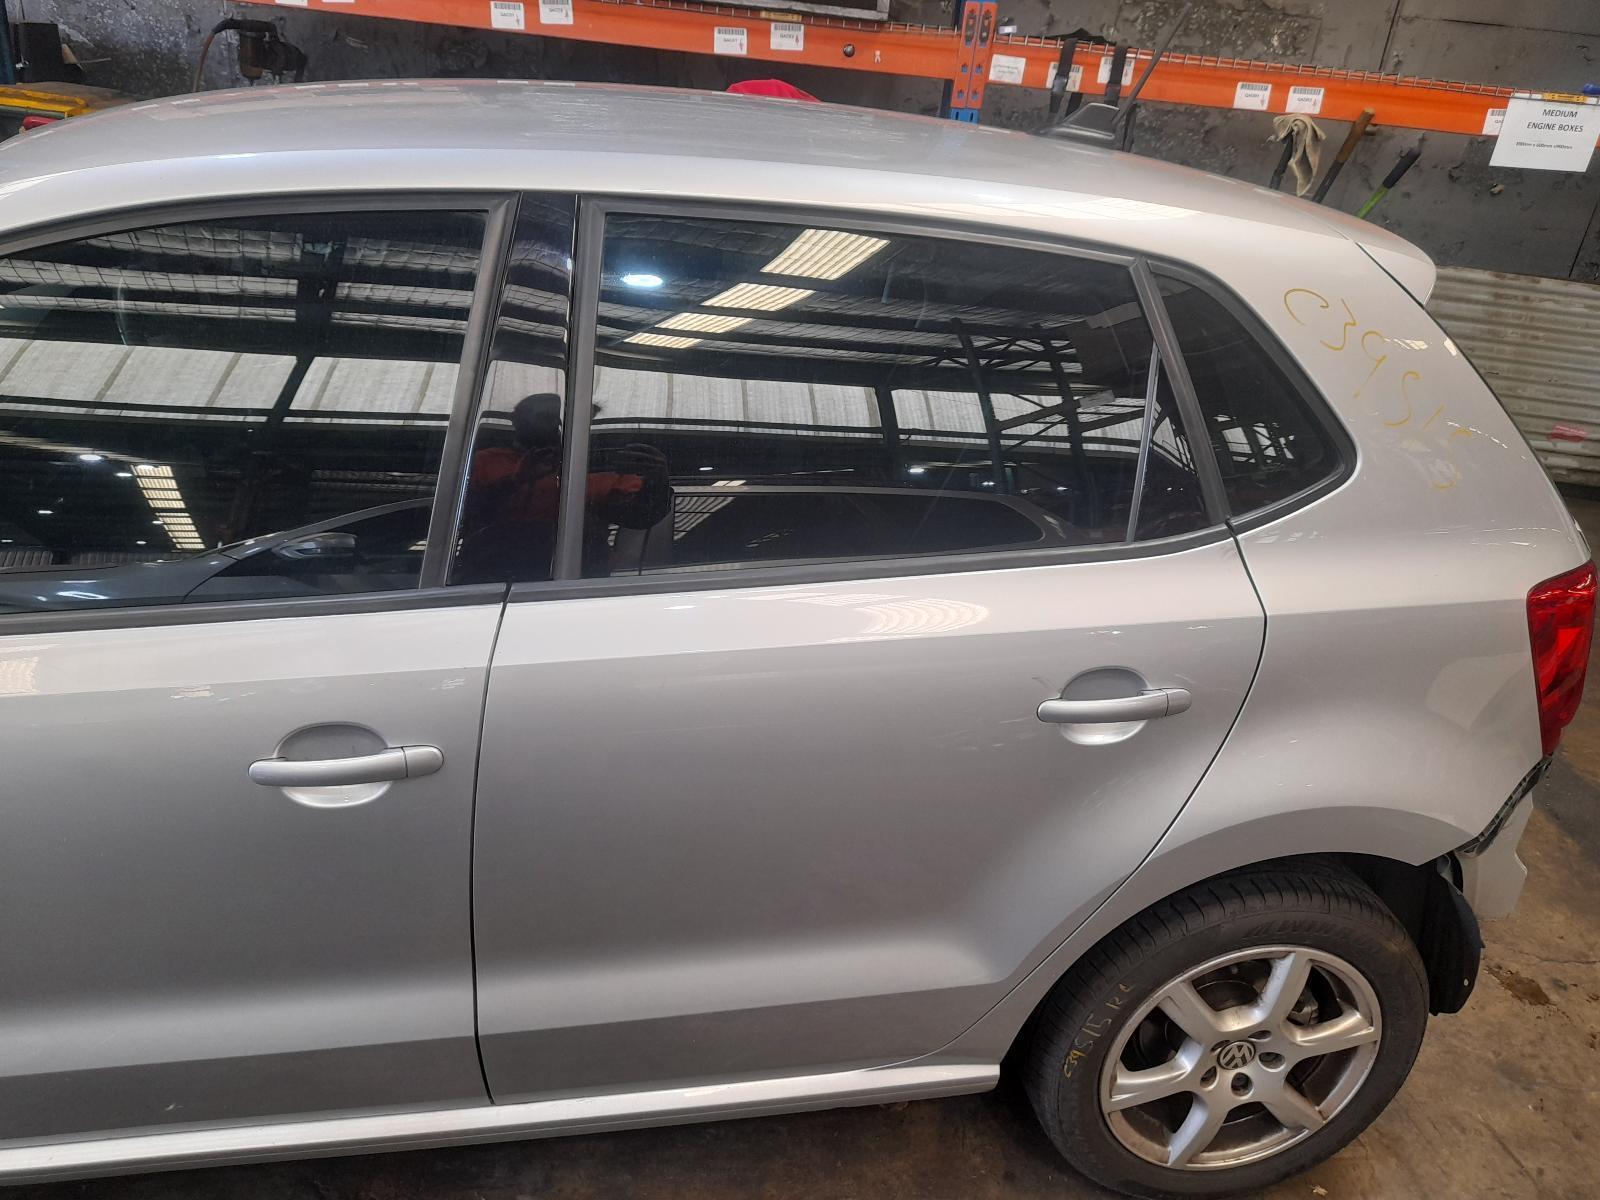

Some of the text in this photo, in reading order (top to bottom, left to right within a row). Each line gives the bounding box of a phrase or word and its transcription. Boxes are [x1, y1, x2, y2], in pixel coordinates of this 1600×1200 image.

[1542, 109, 1578, 118] MEDIUM
[1527, 121, 1584, 133] ENGINE BOXES
